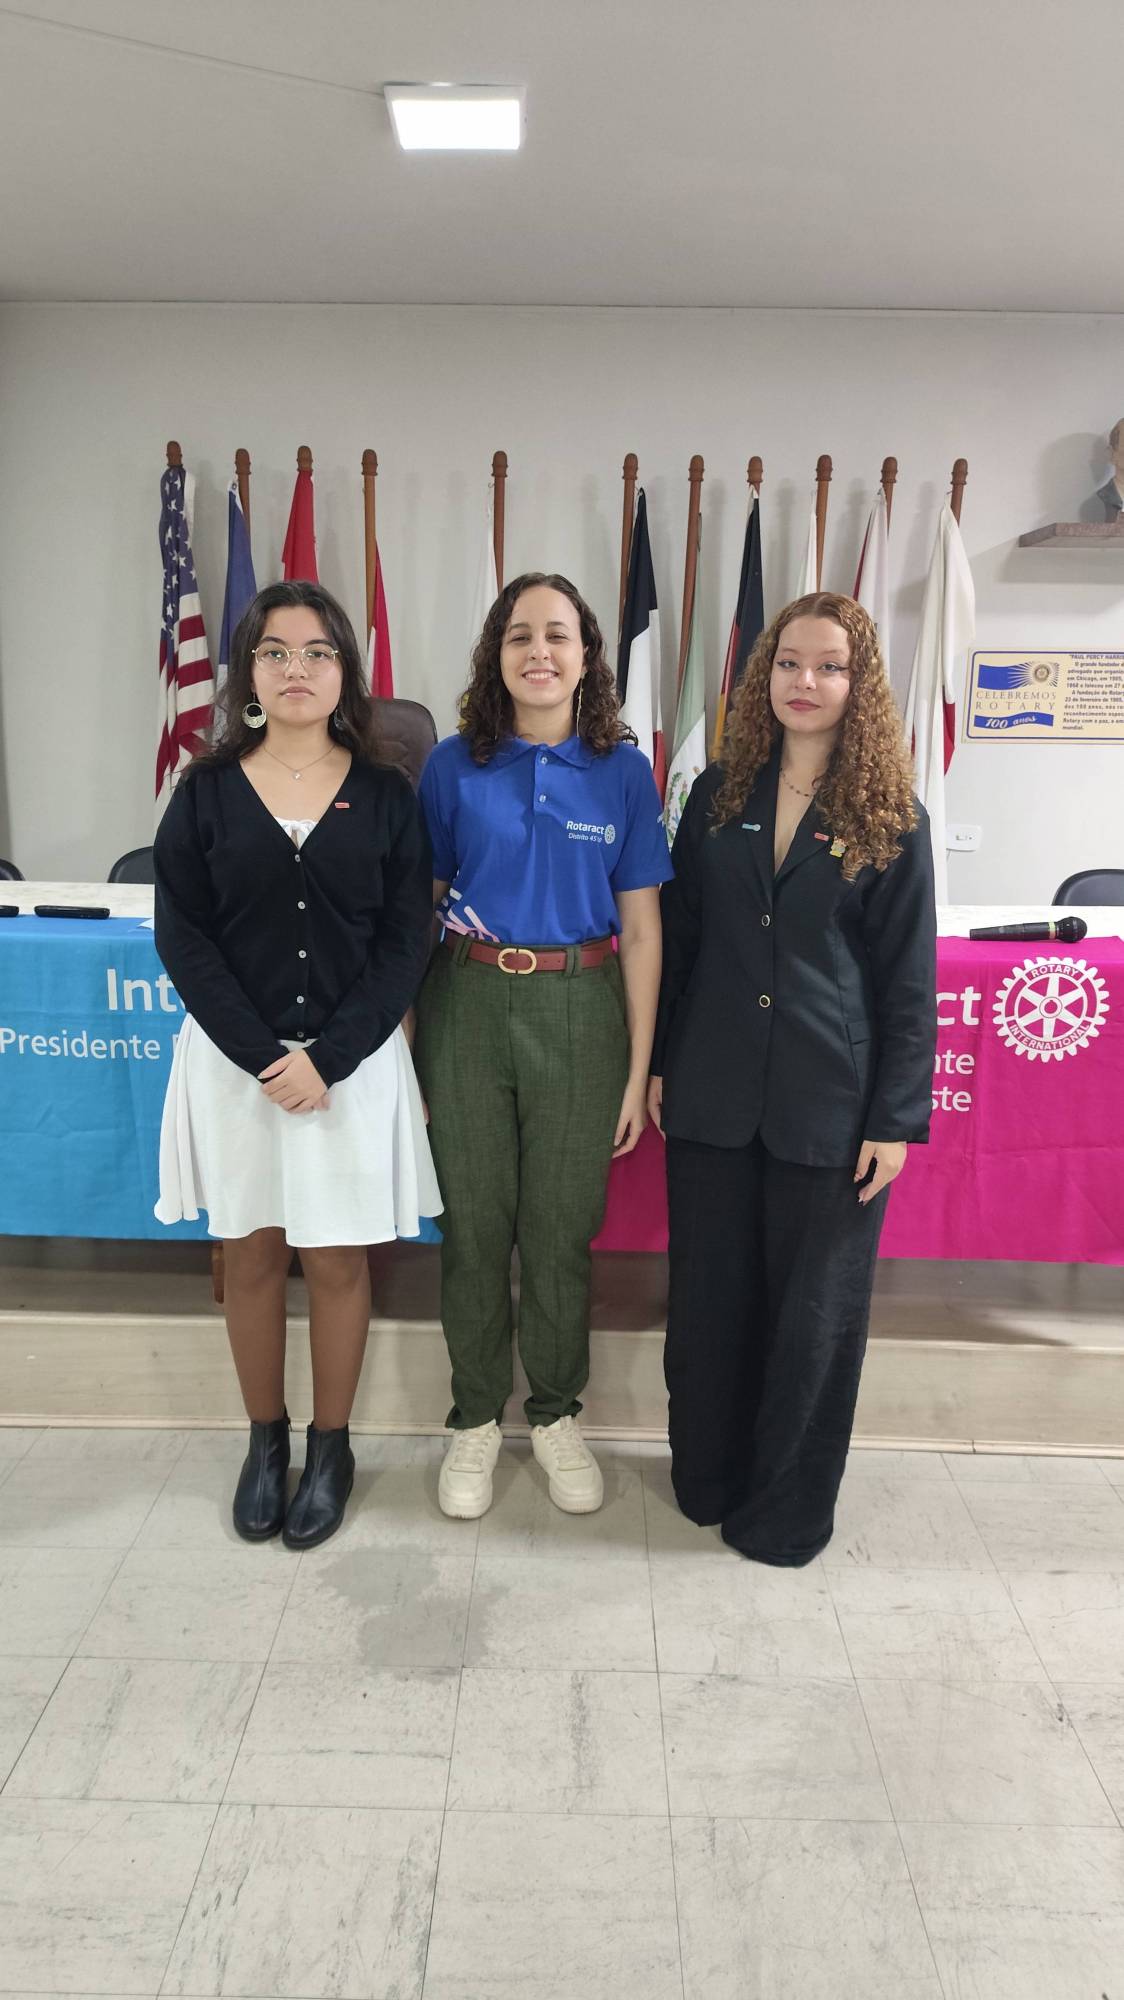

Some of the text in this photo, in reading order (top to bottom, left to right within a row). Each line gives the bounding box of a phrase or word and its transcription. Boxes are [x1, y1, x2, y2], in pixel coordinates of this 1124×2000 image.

[976, 691, 1057, 699] CELEBREMOS
[975, 701, 1057, 710] ROTARY
[985, 716, 1037, 728] 100 anos
[566, 820, 604, 835] Rotaract
[568, 832, 589, 841] Distrito
[1031, 964, 1079, 977] ROTARY
[107, 968, 185, 1012] Int
[936, 986, 981, 1025] ct
[0, 1028, 160, 1059] Presidente
[1010, 1024, 1089, 1050] INTERNATIONAL
